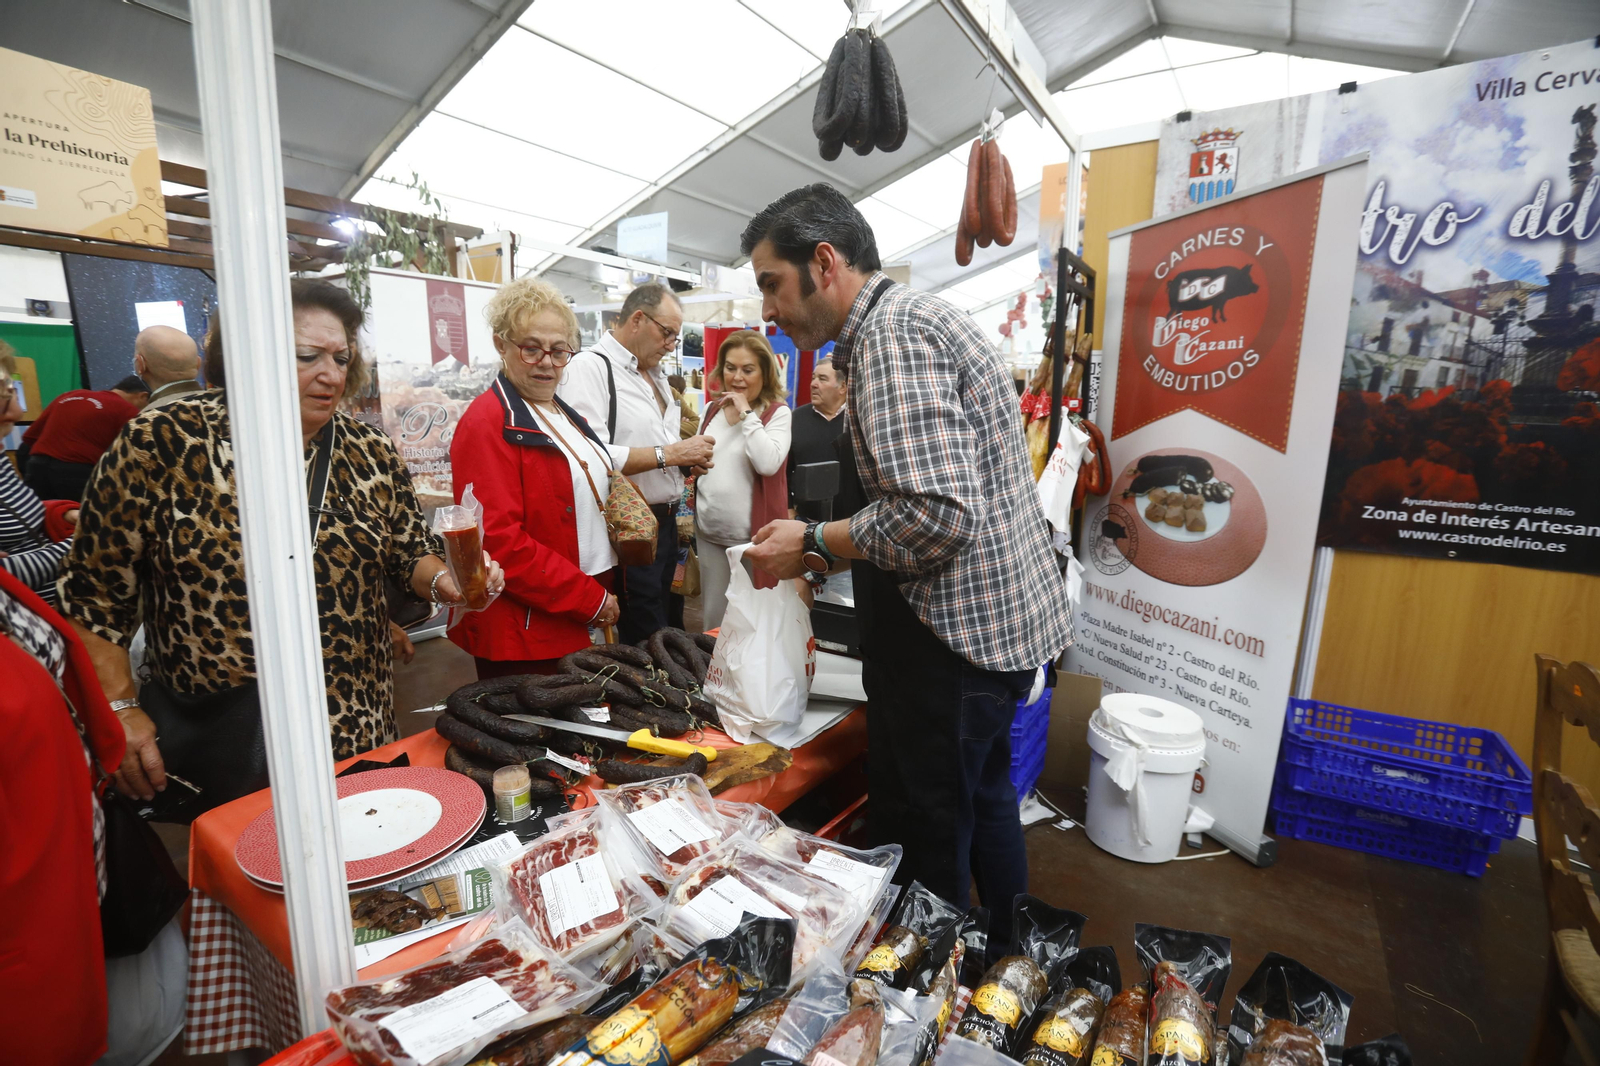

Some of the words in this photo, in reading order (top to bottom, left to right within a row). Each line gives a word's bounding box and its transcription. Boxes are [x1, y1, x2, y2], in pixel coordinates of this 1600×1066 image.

[1476, 77, 1526, 101] Villa
[3, 112, 70, 133] APERTURA
[4, 128, 23, 144] la
[28, 134, 130, 166] Prehistoria
[41, 156, 53, 164] LA
[59, 160, 126, 178] SIERREZUELA
[1359, 181, 1482, 264] tro
[1508, 174, 1600, 241] del
[1154, 227, 1245, 280] CARNES
[1255, 236, 1273, 256] Y
[1153, 313, 1210, 347] Diego
[1174, 330, 1244, 365] Cazani
[1143, 349, 1260, 392] EMBUTIDOS
[404, 446, 445, 458] Historia
[1362, 505, 1408, 521] Zona
[1412, 509, 1437, 524] de
[1441, 511, 1510, 530] Interés
[1402, 497, 1476, 510] Ayuntamiento
[1478, 502, 1493, 511] de
[1494, 503, 1531, 513] Castro
[1533, 506, 1553, 515] del
[1555, 507, 1575, 517] Río
[1398, 529, 1566, 552] www.castrodelrio.es
[1085, 581, 1265, 658] www.diegocazani.com
[1093, 632, 1118, 651] Nueva
[1120, 643, 1142, 661] Salud
[1156, 658, 1167, 671] 23
[1176, 667, 1207, 688] Castro
[1210, 682, 1226, 696] del
[1230, 688, 1252, 708] Río.
[1102, 619, 1128, 637] Madre
[1129, 629, 1155, 648] Isabel
[1168, 645, 1175, 656] 2
[1183, 651, 1215, 672] Castro
[1218, 661, 1235, 679] del
[1238, 671, 1260, 691] Río.
[1079, 643, 1095, 657] Avd.
[1097, 651, 1147, 681] Constitución
[1160, 678, 1167, 689] 3
[1175, 684, 1206, 707] Nueva
[1209, 700, 1253, 729] Carteya.
[654, 984, 697, 1028] ELECCIÓN
[964, 1023, 1003, 1047] BELLOTA
